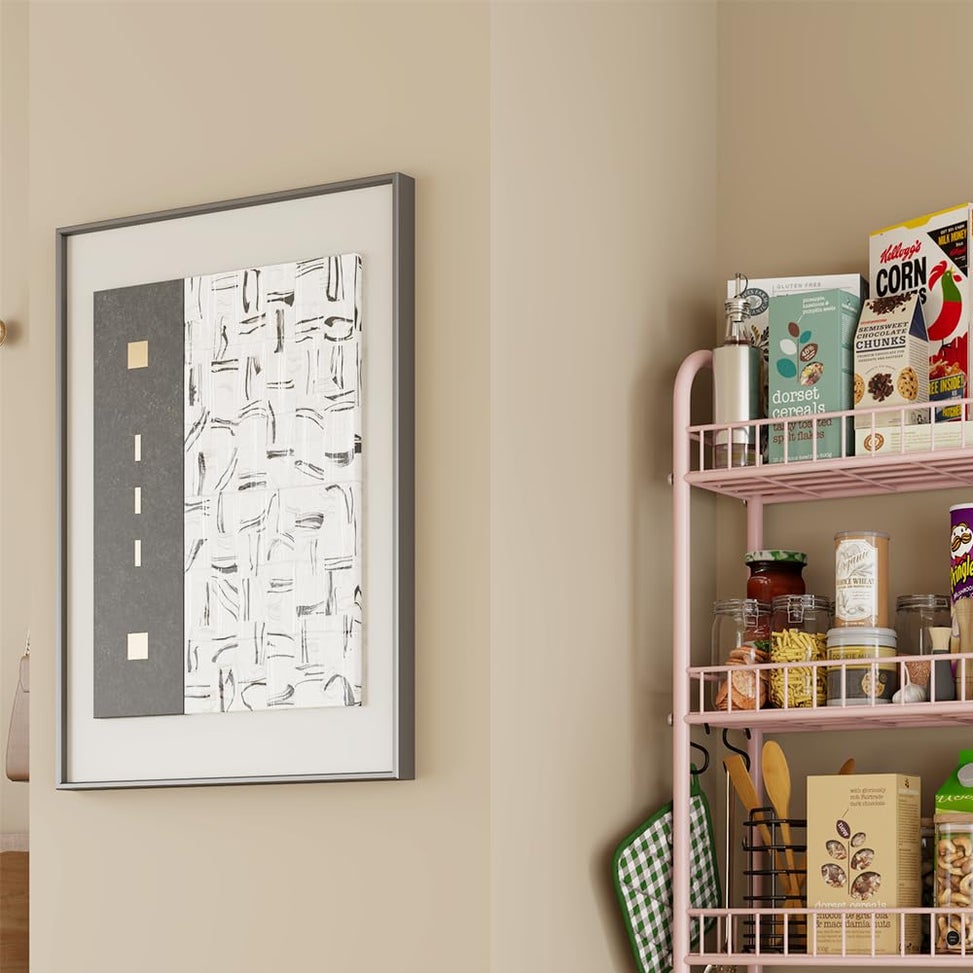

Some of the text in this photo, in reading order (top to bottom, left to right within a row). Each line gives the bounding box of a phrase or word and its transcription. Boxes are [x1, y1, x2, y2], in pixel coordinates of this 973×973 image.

[880, 239, 922, 264] Kellogg's
[876, 256, 926, 297] CORN
[858, 321, 909, 332] SEMISWEET
[857, 328, 907, 340] CHOCOLATE
[856, 336, 906, 350] CHUNKS
[772, 386, 820, 404] dorset
[772, 402, 826, 418] cereals
[798, 418, 832, 429] toated
[773, 432, 796, 444] splt
[856, 912, 888, 921] graola
[824, 920, 871, 928] macdamia
